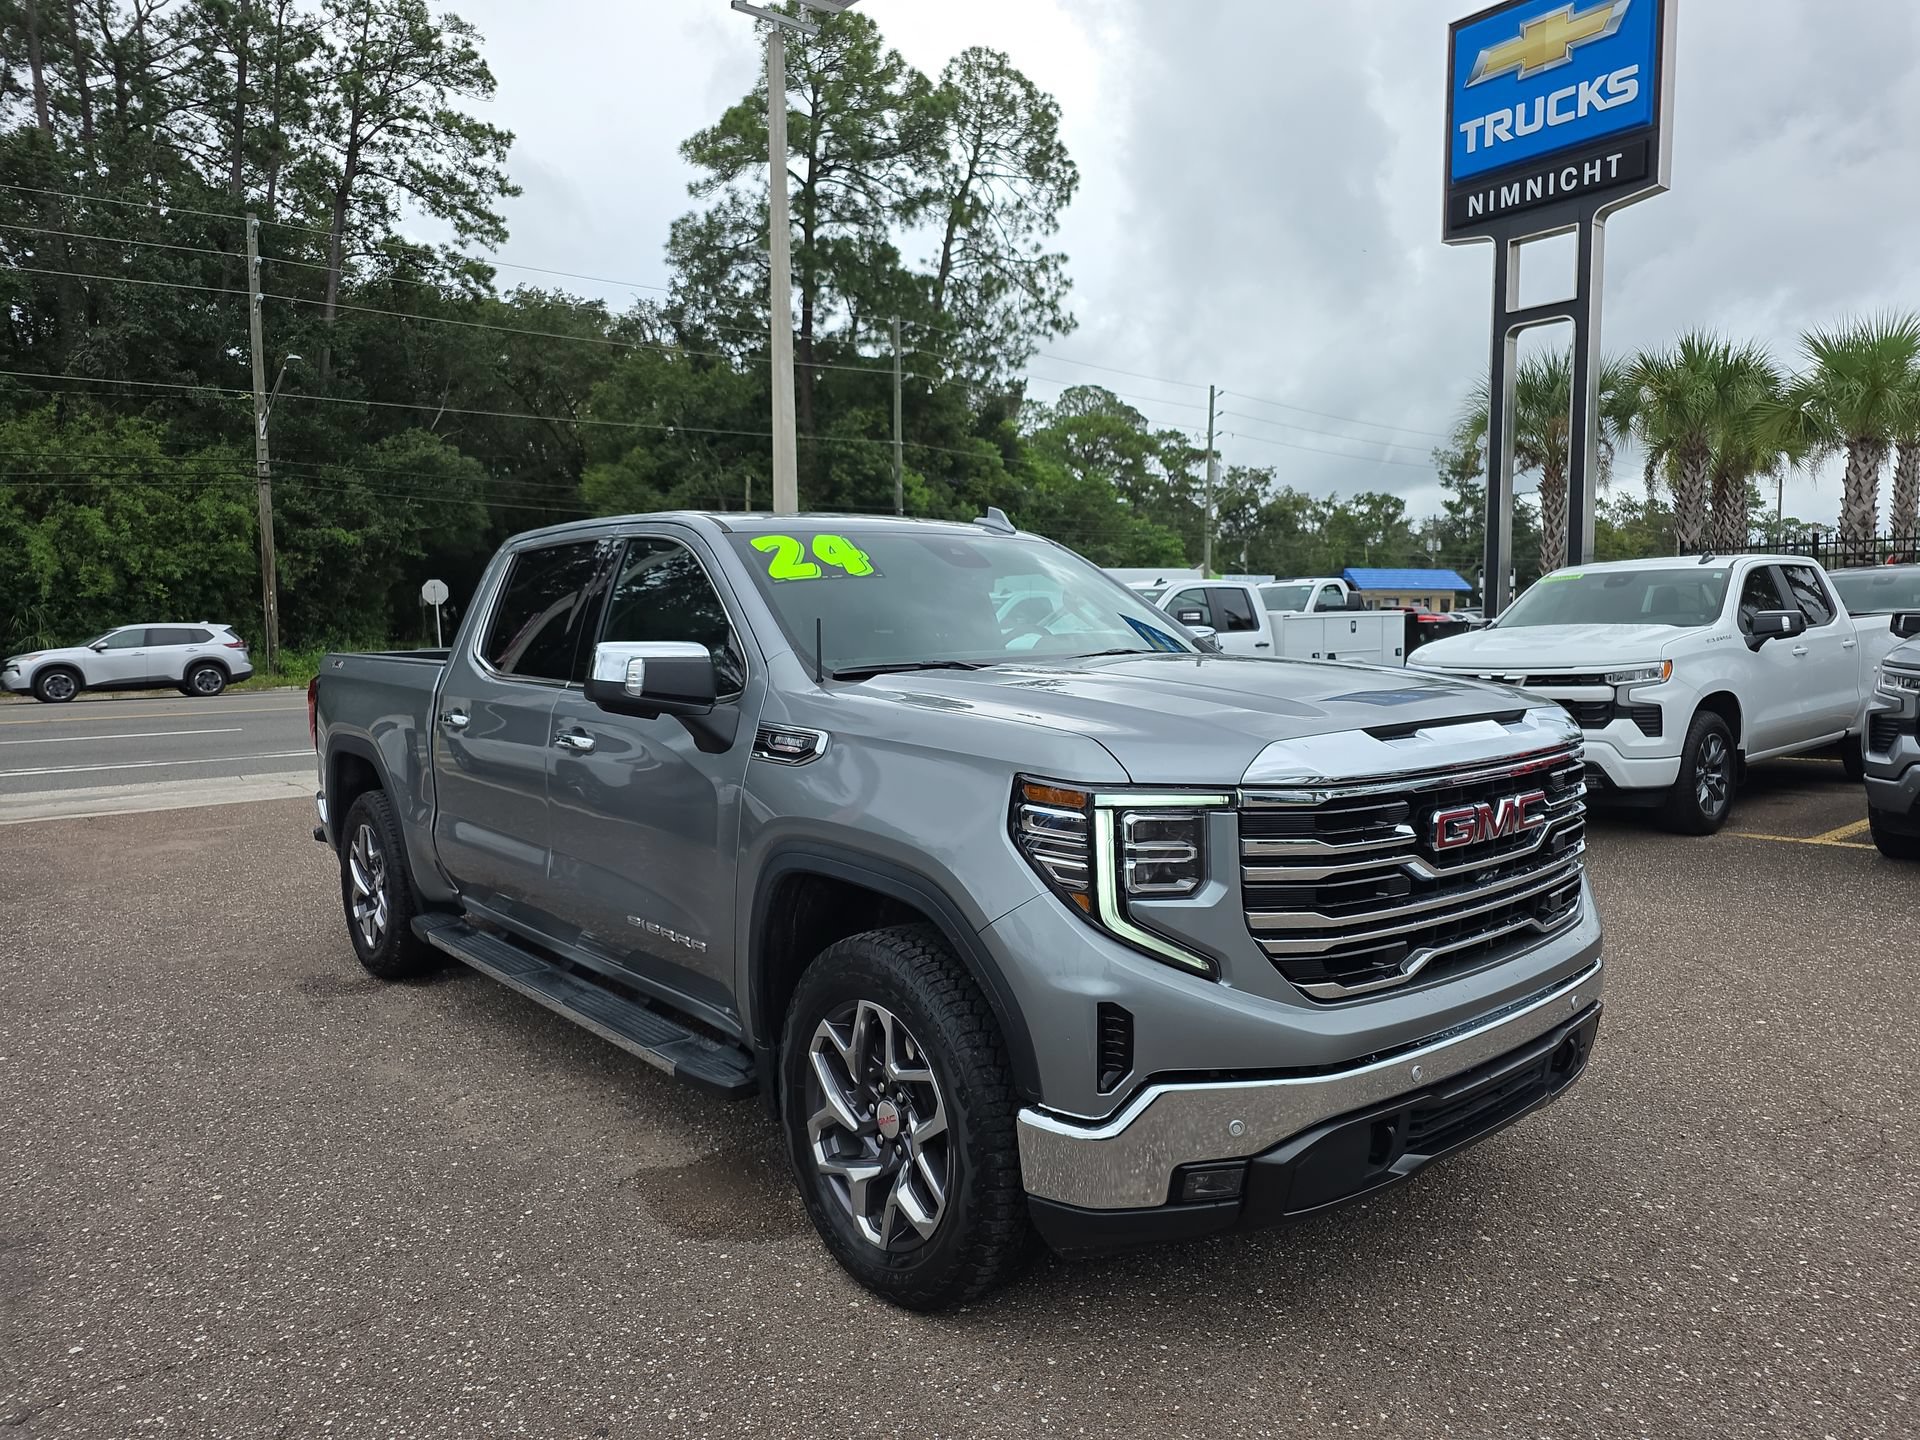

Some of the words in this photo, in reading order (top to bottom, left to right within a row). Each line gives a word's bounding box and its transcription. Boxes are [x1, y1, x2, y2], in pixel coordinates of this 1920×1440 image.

[1459, 64, 1639, 154] TRUCKS
[1467, 153, 1622, 217] NIMNICHT
[750, 534, 875, 581] 24
[1432, 790, 1545, 851] GMC
[626, 915, 707, 953] SIERRA
